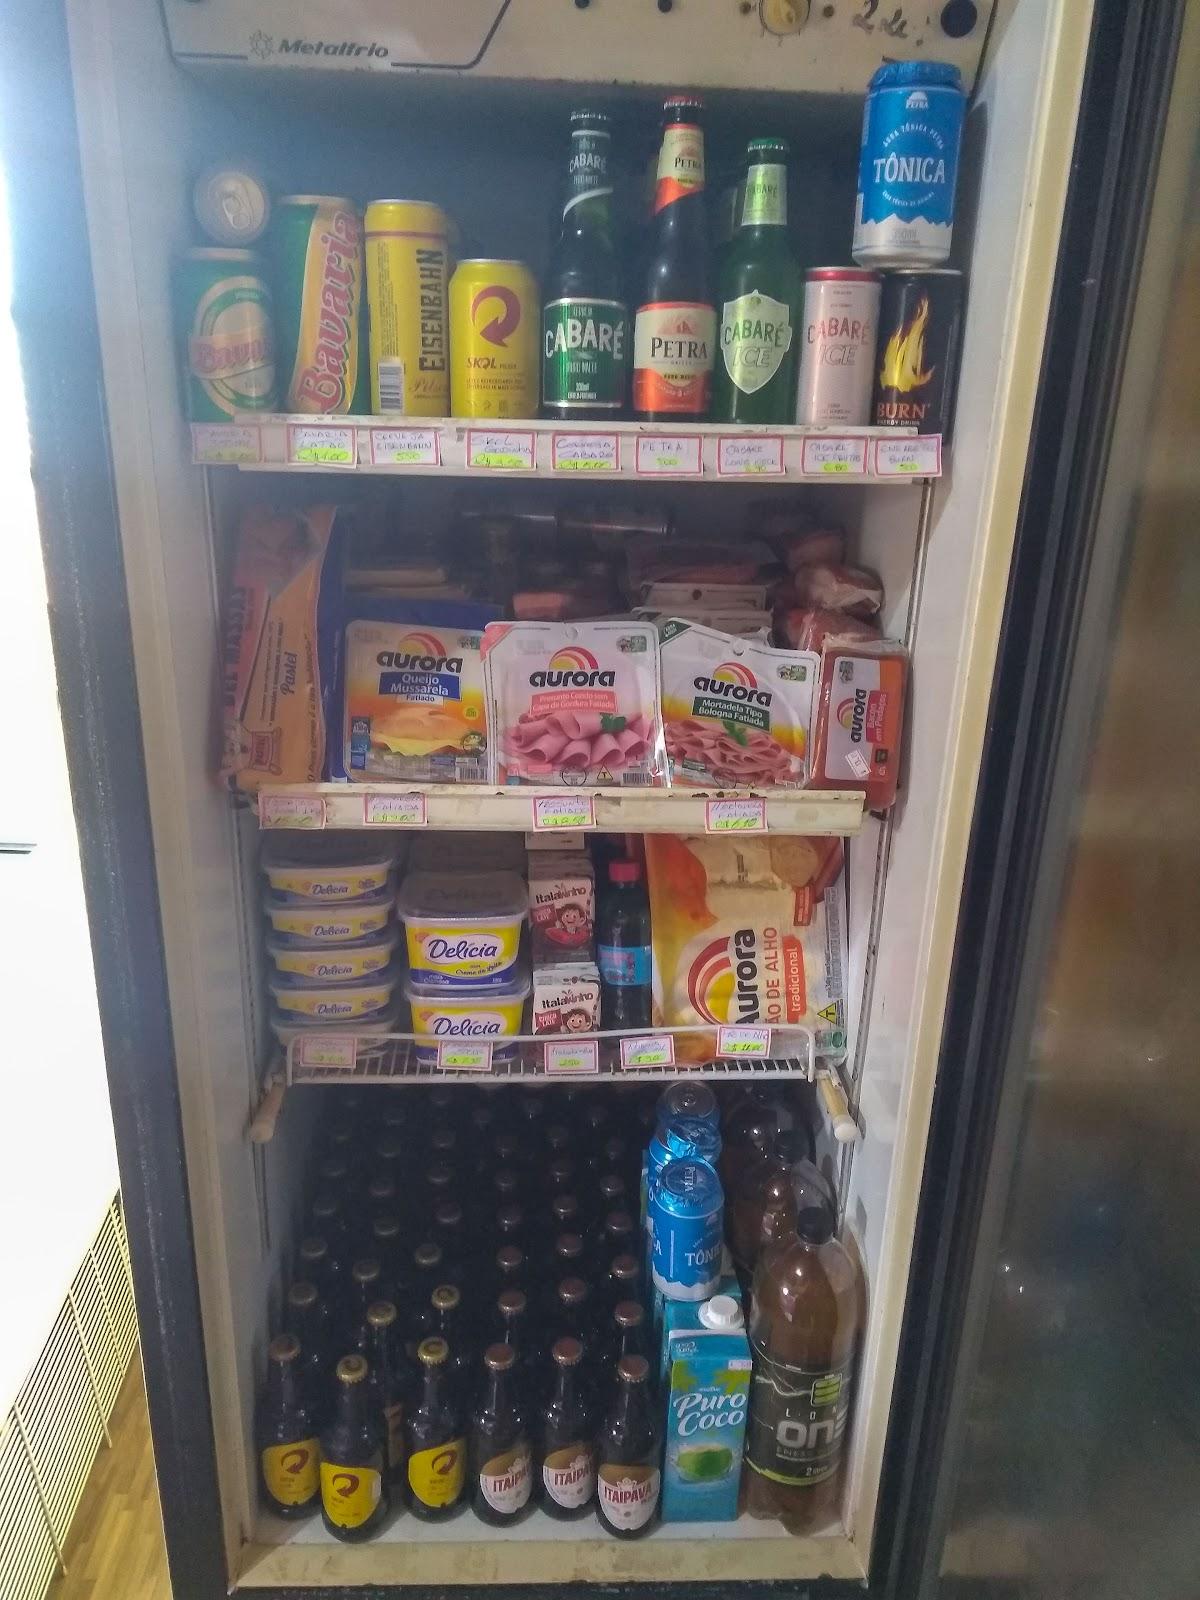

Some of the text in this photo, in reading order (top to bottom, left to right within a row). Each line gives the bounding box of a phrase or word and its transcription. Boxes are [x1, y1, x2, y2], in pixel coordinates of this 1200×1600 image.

[278, 37, 389, 58] Metalfrio
[873, 152, 946, 184] TÔNICA
[300, 210, 359, 415] Bavaria
[416, 249, 445, 372] EISENBAHN
[545, 319, 624, 360] CABARÉ
[724, 319, 785, 348] CABARÉ
[807, 317, 870, 345] CABARÉ
[651, 337, 708, 359] PETRA
[732, 346, 773, 368] ICE
[819, 343, 857, 367] ICE
[876, 402, 925, 419] BURN
[280, 651, 298, 696] Pastel
[376, 650, 464, 673] aurora
[390, 682, 449, 696] Mussarela
[401, 673, 440, 685] Queijo
[529, 671, 616, 687] aurora
[693, 676, 773, 707] aurora
[698, 706, 764, 727] Bologna Fatiada
[702, 699, 763, 718] Mortadela Tipo
[851, 688, 867, 743] aurora
[763, 927, 780, 972] ALHO
[766, 979, 780, 999] DE
[786, 946, 801, 1013] tradicional
[672, 1393, 747, 1418] Puro
[677, 1410, 745, 1437] Coco
